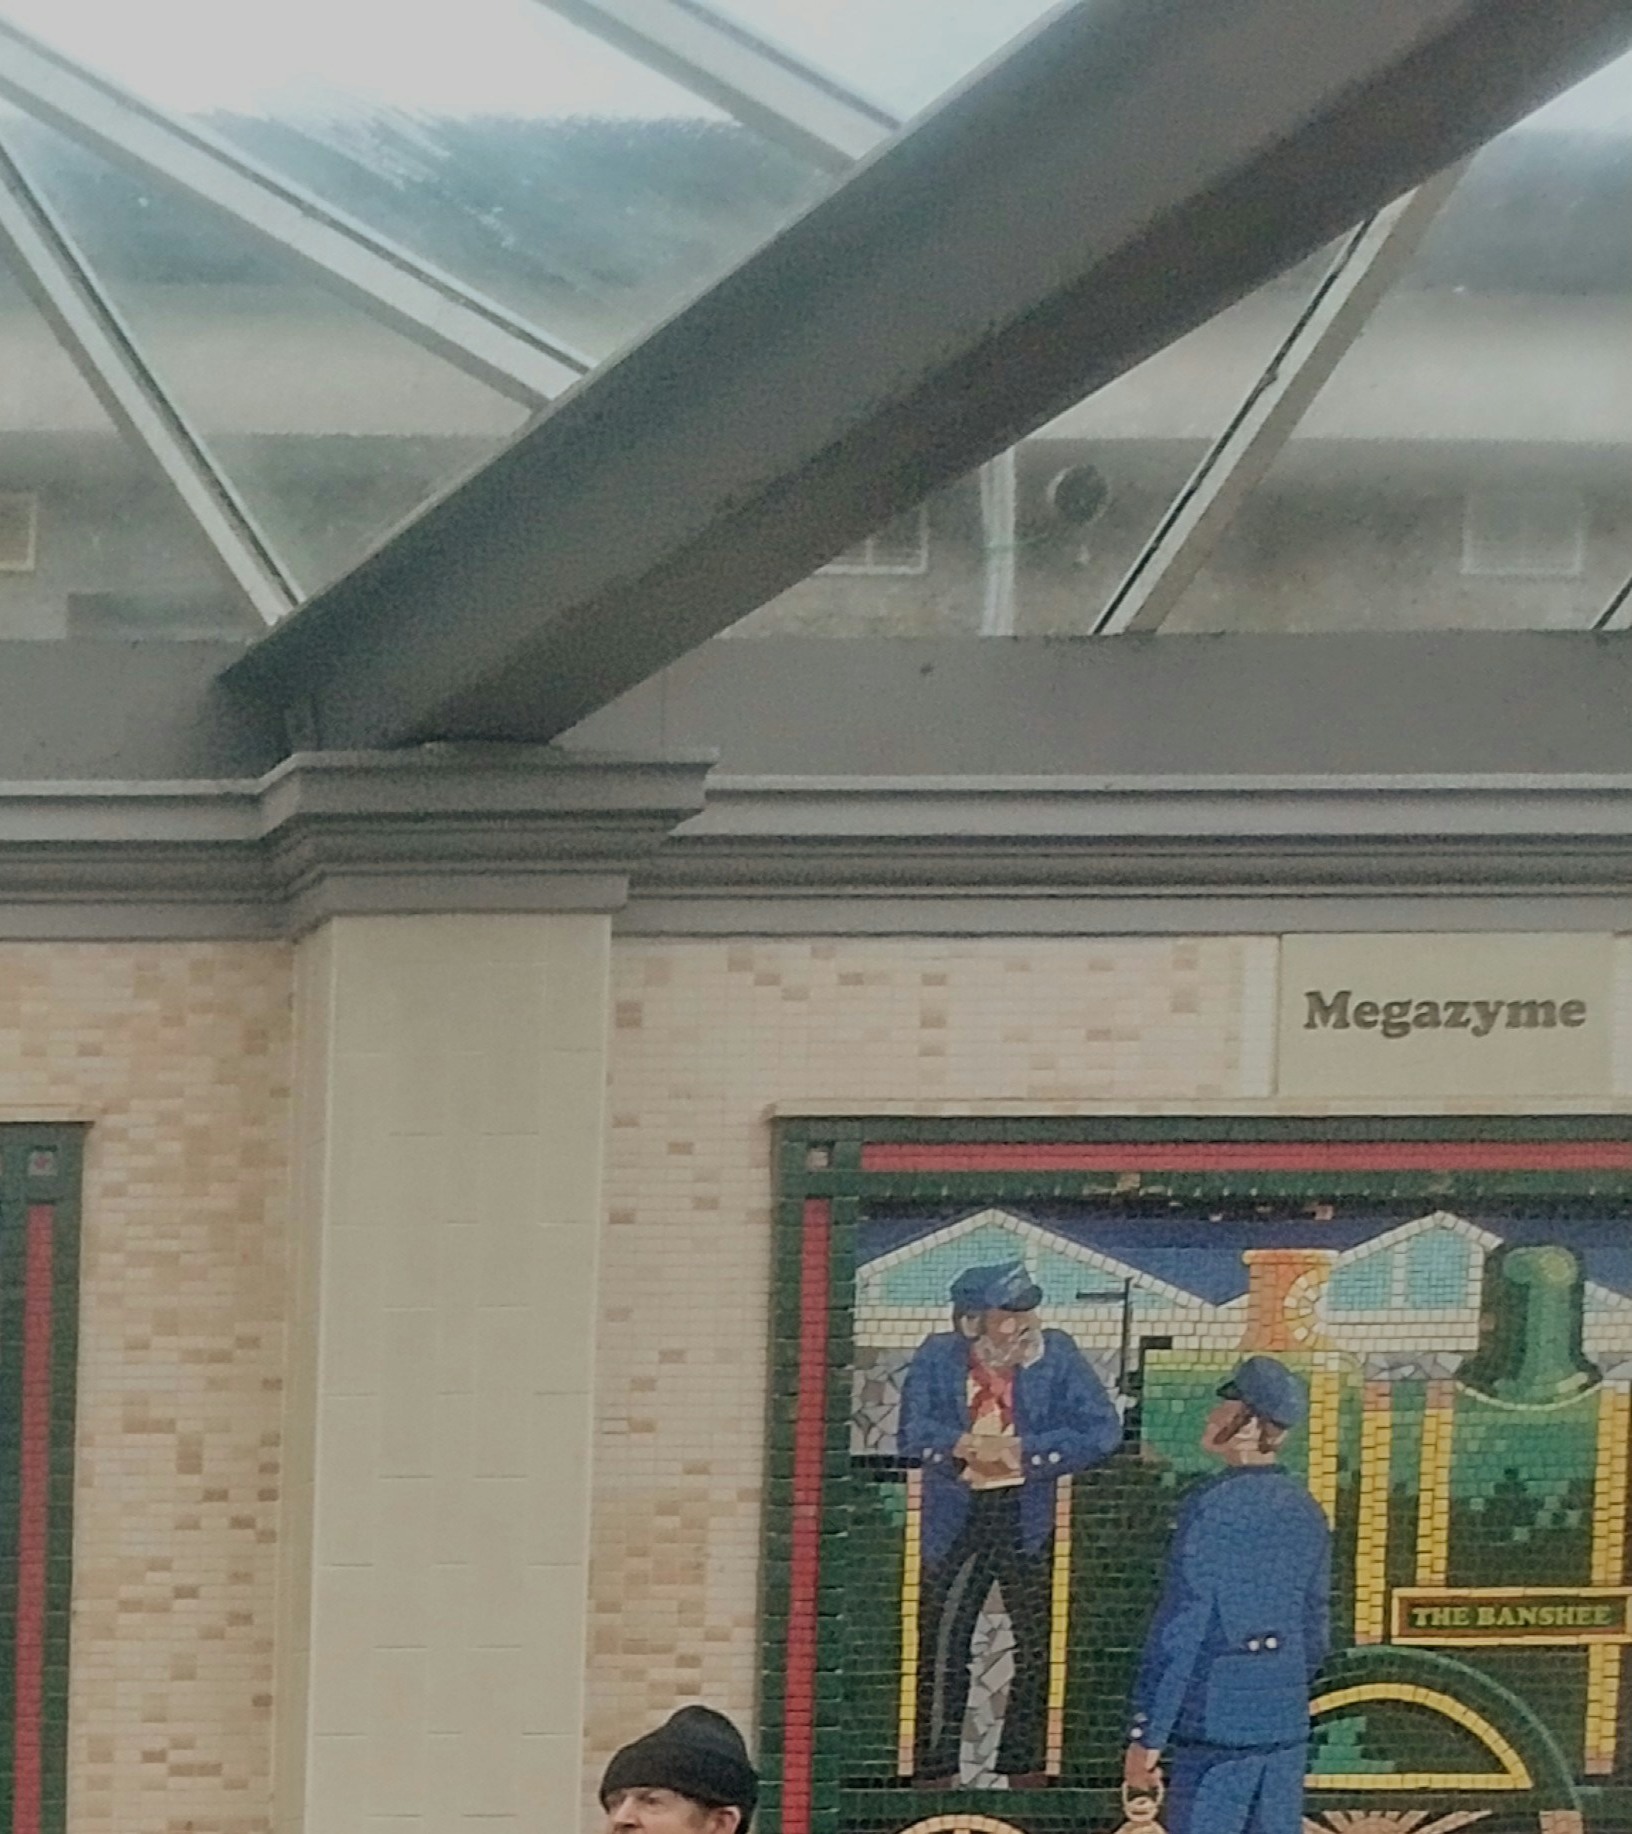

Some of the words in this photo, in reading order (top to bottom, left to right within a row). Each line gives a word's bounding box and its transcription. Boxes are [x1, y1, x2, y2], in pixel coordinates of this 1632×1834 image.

[1303, 990, 1587, 1040] Megazyme
[1411, 1606, 1469, 1626] THE
[1476, 1606, 1612, 1626] BANSHEE
